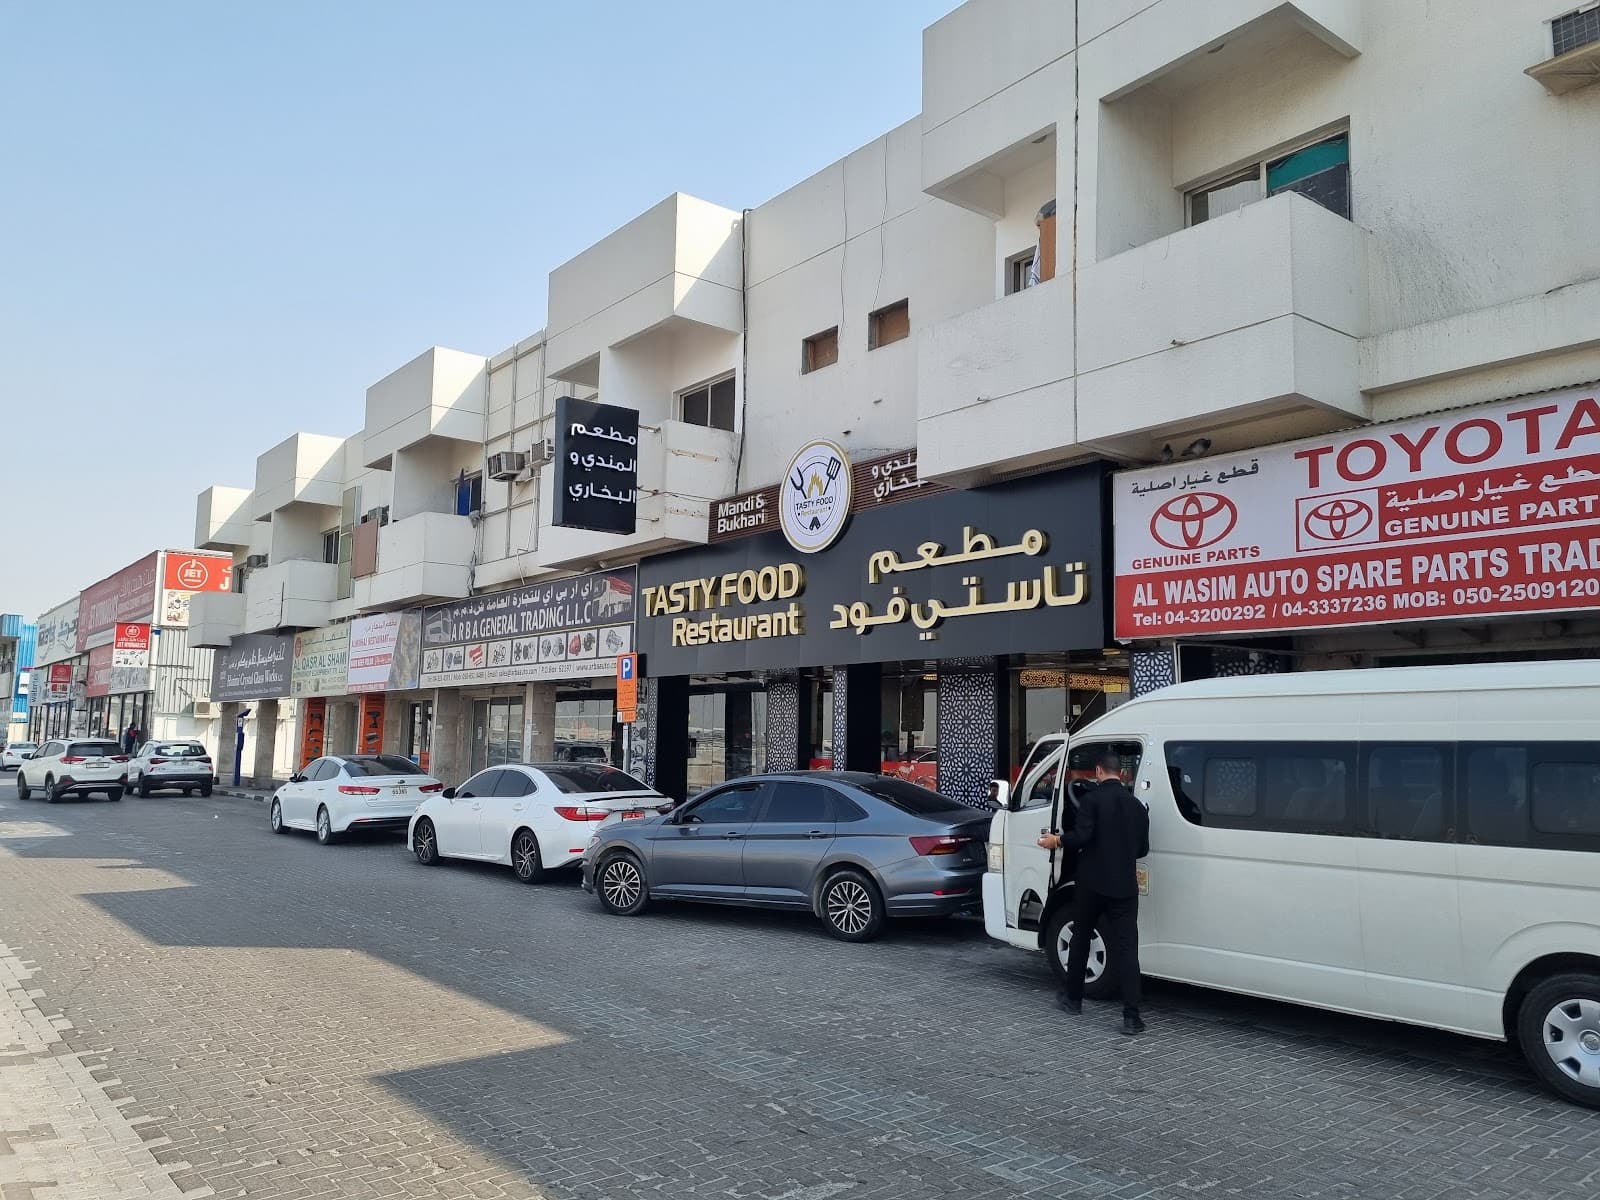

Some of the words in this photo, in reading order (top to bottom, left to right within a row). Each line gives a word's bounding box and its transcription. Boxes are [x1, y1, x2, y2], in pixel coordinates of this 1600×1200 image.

[570, 422, 637, 446] مطعم
[1294, 398, 1600, 488] TOYOTA
[569, 451, 580, 466] و
[581, 454, 637, 473] المندي
[1216, 458, 1260, 484] قطع
[871, 464, 880, 480] و
[1178, 470, 1214, 490] غيار
[1538, 465, 1600, 492] طع
[568, 482, 637, 505] البخاري
[1131, 476, 1177, 498] اصلية
[1385, 481, 1466, 512] اصلية
[1468, 472, 1532, 502] غيار
[718, 496, 755, 519] Mandi
[755, 493, 768, 509] &
[795, 499, 815, 511] TASTY
[815, 496, 834, 508] FOOD
[717, 510, 767, 534] Bukhari
[1384, 505, 1510, 537] GENUINE
[867, 525, 1048, 585] مطعم
[1132, 552, 1202, 571] GENUINE
[1206, 545, 1262, 563] PARTS
[183, 568, 203, 579] JET
[1132, 583, 1159, 608] AL
[1163, 574, 1236, 605] WASIM
[1243, 568, 1309, 599] AUTO
[1316, 558, 1403, 592] SPARE
[1411, 547, 1510, 585] PARTS
[641, 576, 719, 618] TASTY
[720, 562, 805, 607] FOOD
[910, 561, 1089, 642] تاستي
[1132, 612, 1162, 627] Tel:
[1164, 603, 1266, 625] 04-3200292
[1281, 594, 1387, 618] 04-3337236
[1393, 590, 1447, 609] MOB:
[1452, 577, 1600, 605] 050-2509120
[480, 613, 519, 638] GENERAL
[520, 605, 564, 633] TRADING
[829, 585, 911, 636] فود
[671, 601, 801, 648] Restaurant
[318, 655, 326, 668] AL
[327, 652, 347, 666] SHAMI
[575, 661, 617, 673] www.arbaauto.co
[622, 658, 631, 680] P
